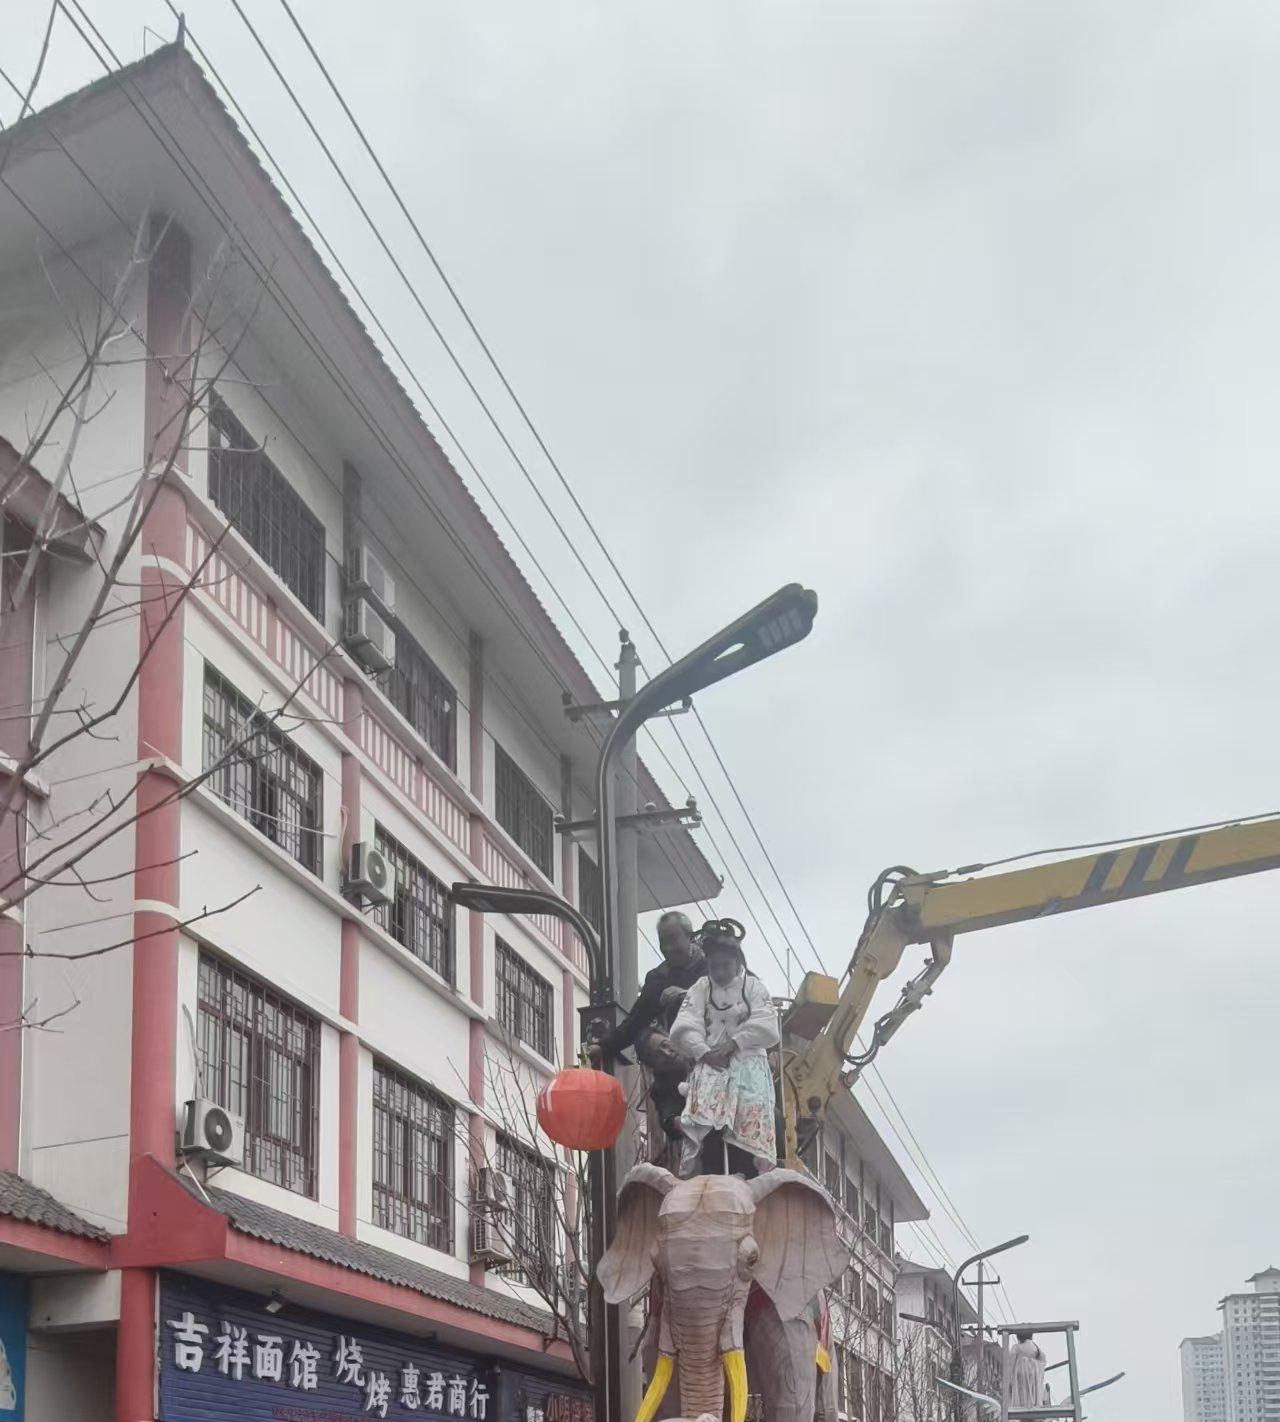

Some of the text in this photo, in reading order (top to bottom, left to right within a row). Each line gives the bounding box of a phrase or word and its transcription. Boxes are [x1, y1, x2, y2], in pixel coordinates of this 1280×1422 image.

[166, 1311, 321, 1390] 吉祥面馆
[335, 1334, 392, 1418] 烧烤
[400, 1362, 490, 1420] 惠君商行
